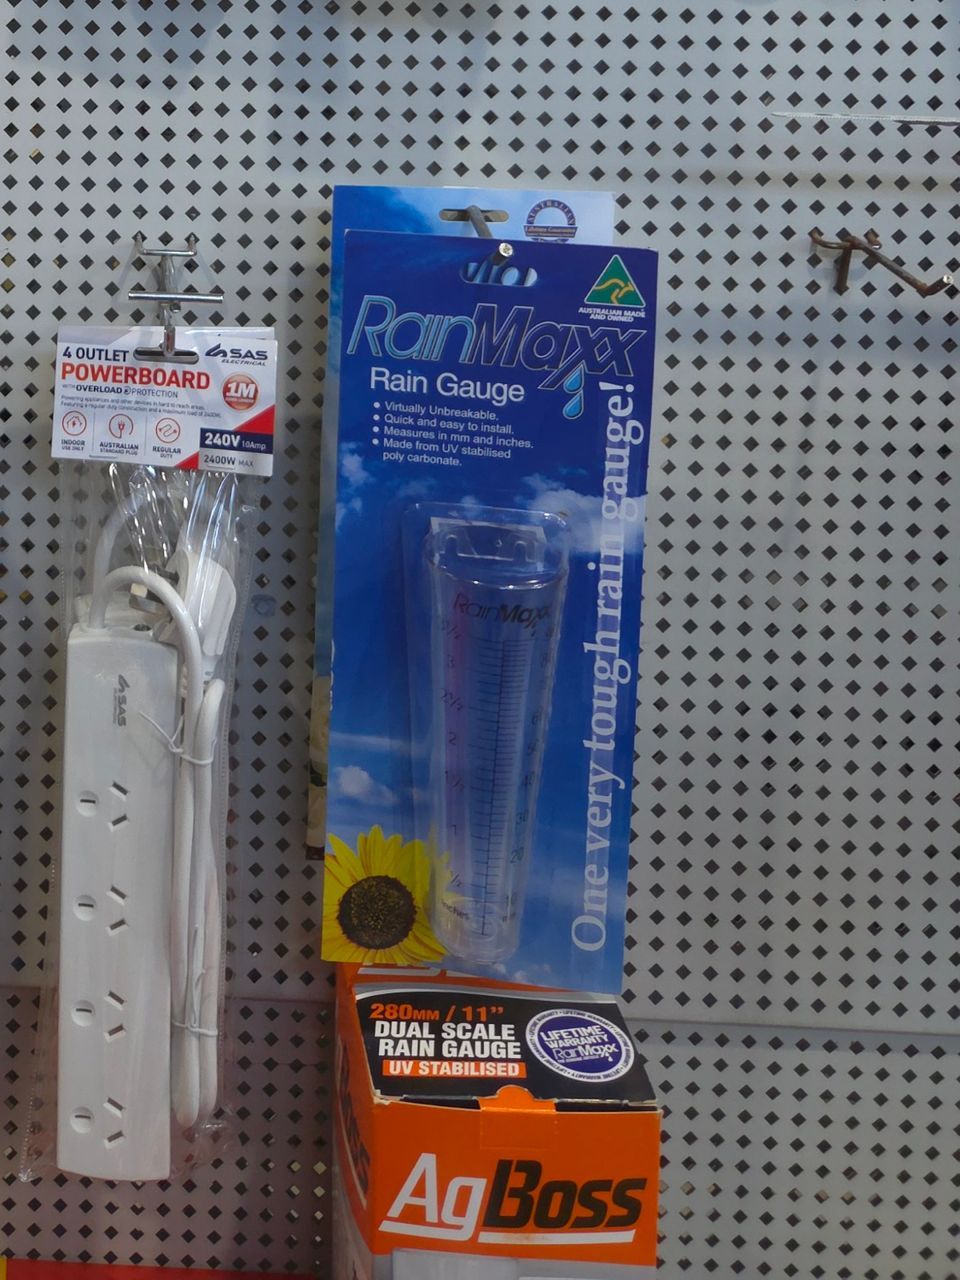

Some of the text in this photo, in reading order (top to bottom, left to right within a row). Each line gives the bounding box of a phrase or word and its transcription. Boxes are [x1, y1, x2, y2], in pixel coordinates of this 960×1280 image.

[578, 306, 646, 319] AUSTRALIAN MADE
[346, 294, 648, 391] RainMaxx
[62, 346, 130, 362] 4 OUTLET
[221, 358, 266, 367] ELECTRICAL
[229, 349, 268, 360] SAS
[61, 362, 210, 390] POWERBOARD
[75, 383, 179, 399] OVERLOAD PROTECTION
[225, 381, 255, 398] 1M
[369, 366, 525, 407] Rain Gauge
[384, 400, 499, 422] Virtually Unbreakable.
[384, 413, 515, 435] Quick and easy to install.
[99, 441, 139, 451] AUSTRALIAN
[204, 431, 267, 450] 240V 10Amp
[383, 425, 534, 450] Measures in mm and inches.
[152, 446, 182, 454] REGULAR
[382, 438, 511, 459] Made from UV stabilised
[203, 454, 254, 467] 2400W MAX
[382, 451, 462, 467] poly carbonate.
[571, 380, 646, 952] One very tough rain gauge!
[374, 1020, 516, 1042] DUAL SCALE
[540, 1025, 606, 1041] LIFETIME
[378, 1039, 522, 1060] RAIN GAUGE
[544, 1034, 609, 1049] WARRANTY
[388, 1060, 520, 1077] UV STABILISED
[386, 1152, 648, 1241] AgBoss
